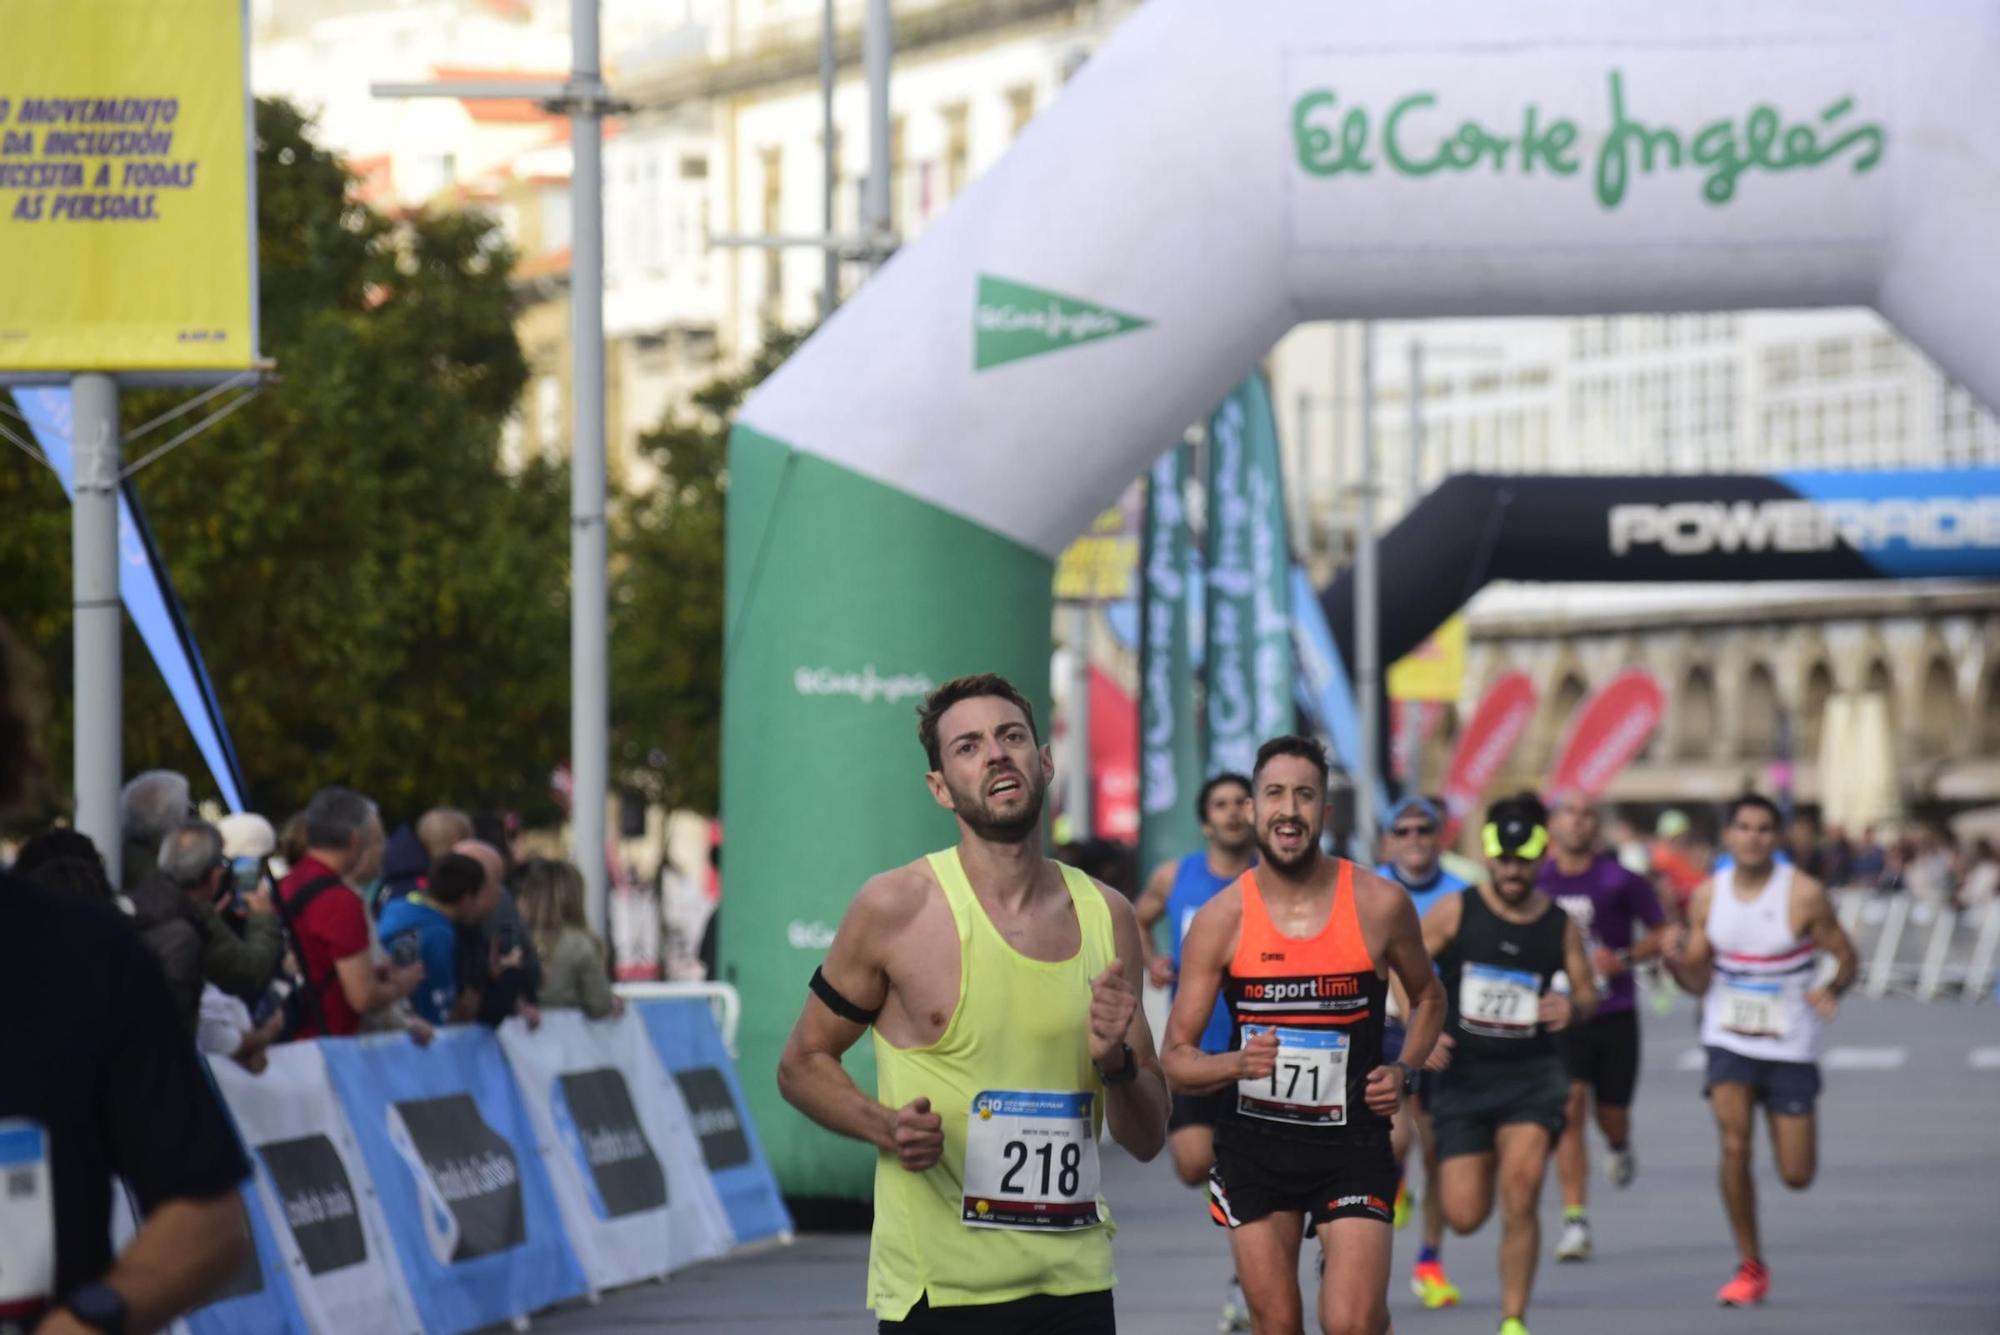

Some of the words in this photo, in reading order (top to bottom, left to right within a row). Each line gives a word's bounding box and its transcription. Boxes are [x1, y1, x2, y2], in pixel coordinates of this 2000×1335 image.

[18, 97, 179, 124] MOVEMENTO
[2, 131, 34, 155] DA
[44, 127, 173, 156] INCLUSIÓN
[1294, 89, 1376, 177] El
[1383, 91, 1583, 177] Corte
[1595, 68, 1885, 209] Inglés
[94, 163, 110, 187] A
[123, 162, 198, 188] TODAS
[12, 195, 45, 220] AS
[50, 194, 160, 221] PERSOAS.
[1607, 498, 2000, 556] POWERADE
[1244, 976, 1360, 1004] nosportlimit
[1270, 1063, 1320, 1101] 171
[1000, 1140, 1081, 1197] 218
